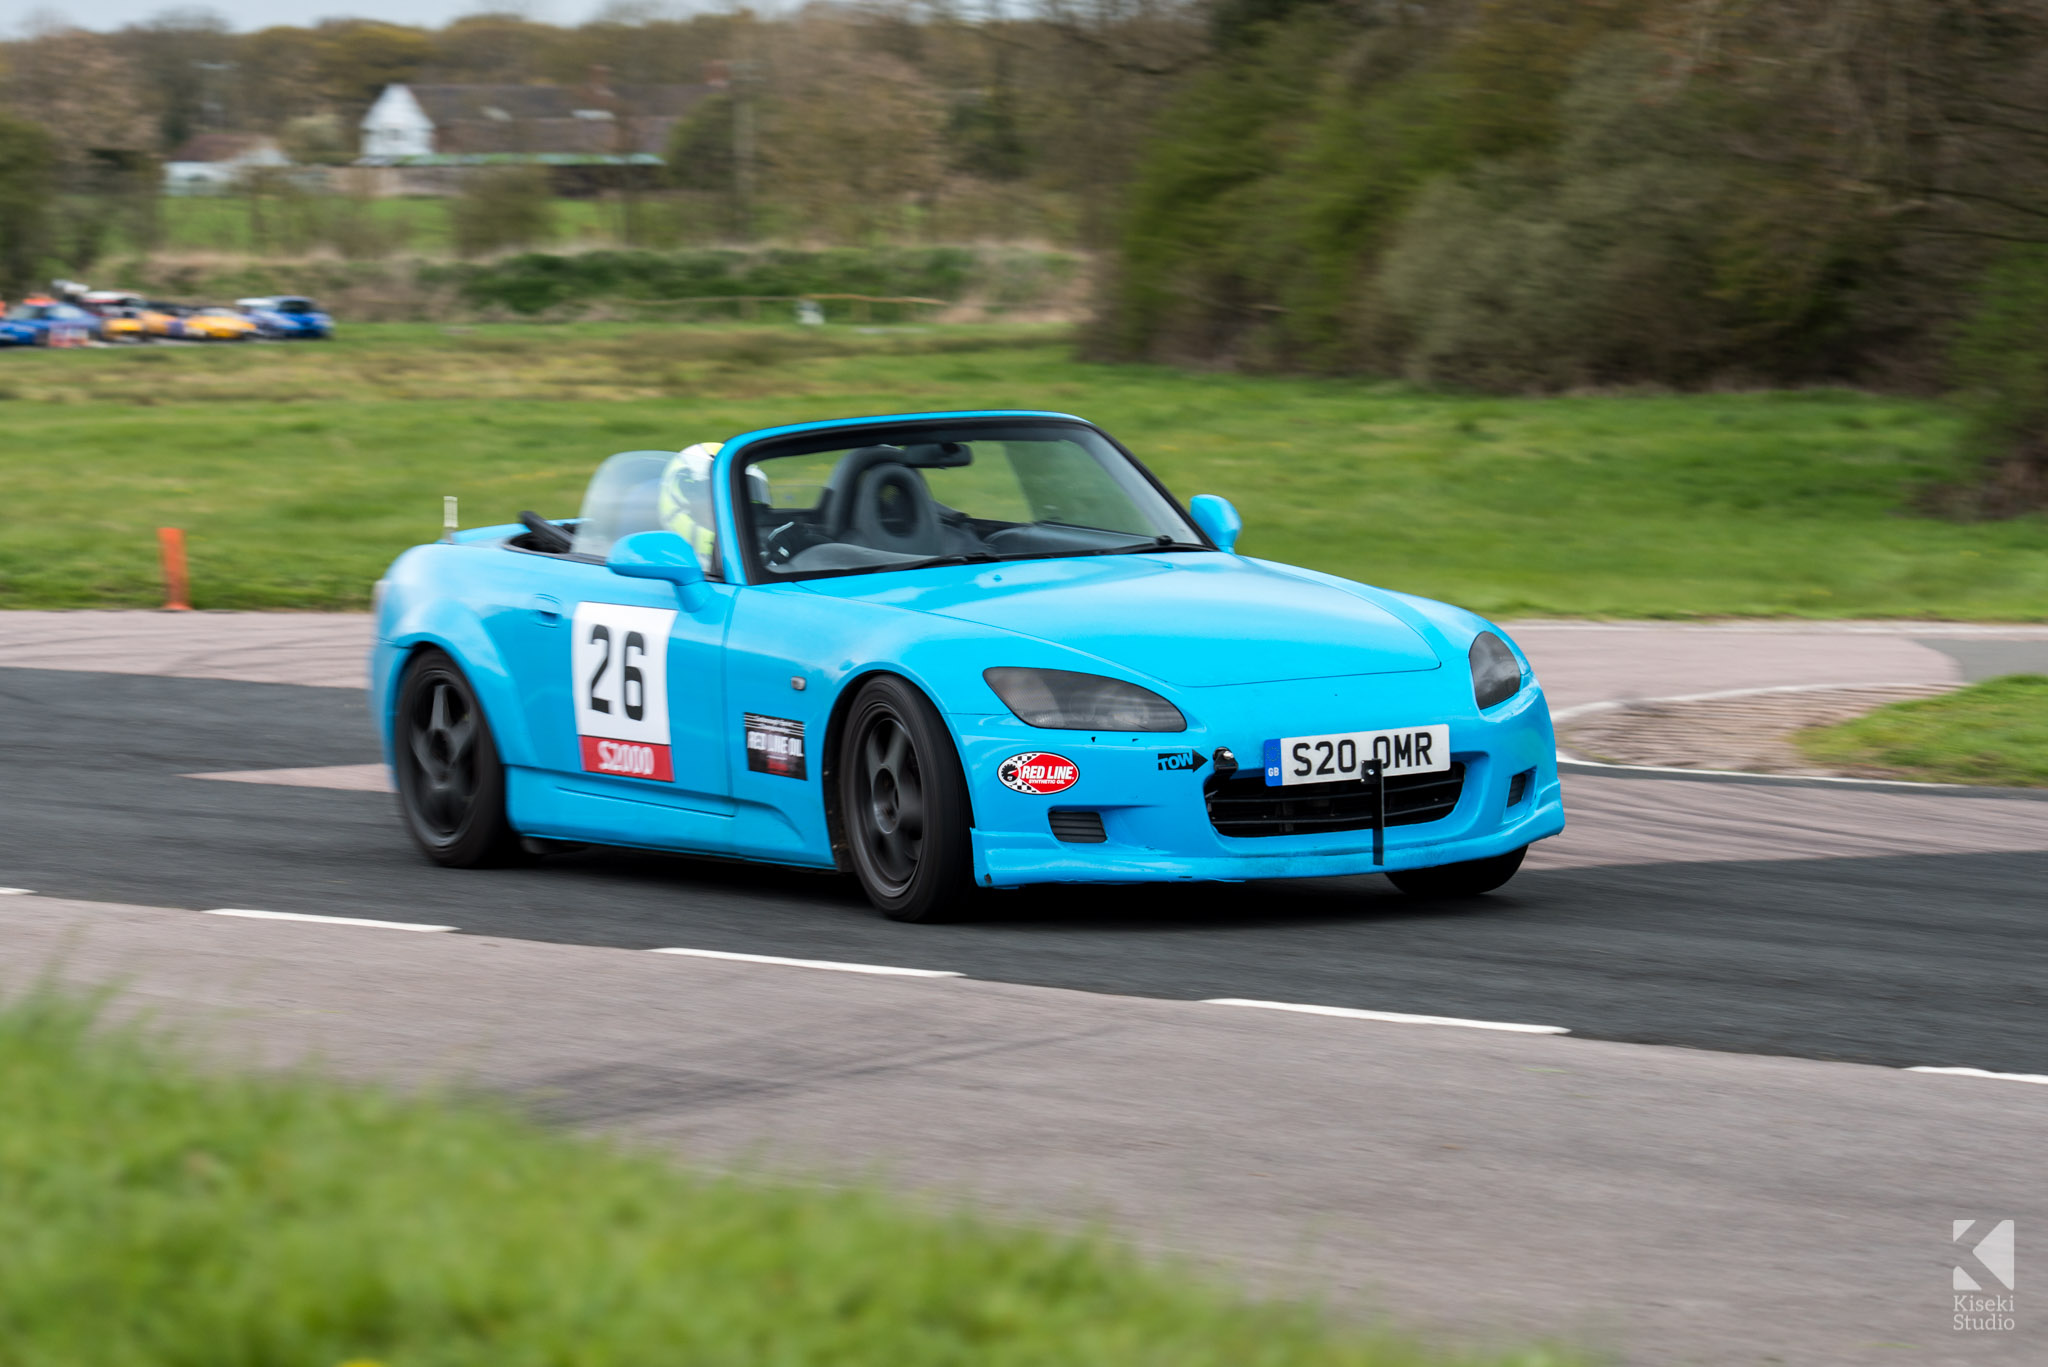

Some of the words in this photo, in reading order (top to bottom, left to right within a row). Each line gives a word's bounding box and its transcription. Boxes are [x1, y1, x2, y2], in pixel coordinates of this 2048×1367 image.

[588, 624, 647, 721] 26
[597, 741, 654, 775] S2000
[1158, 752, 1194, 771] TOW
[1292, 739, 1356, 777] S20
[1373, 732, 1433, 769] OMR
[1022, 765, 1045, 779] RED
[1047, 766, 1073, 780] LINE
[1267, 767, 1280, 777] GB
